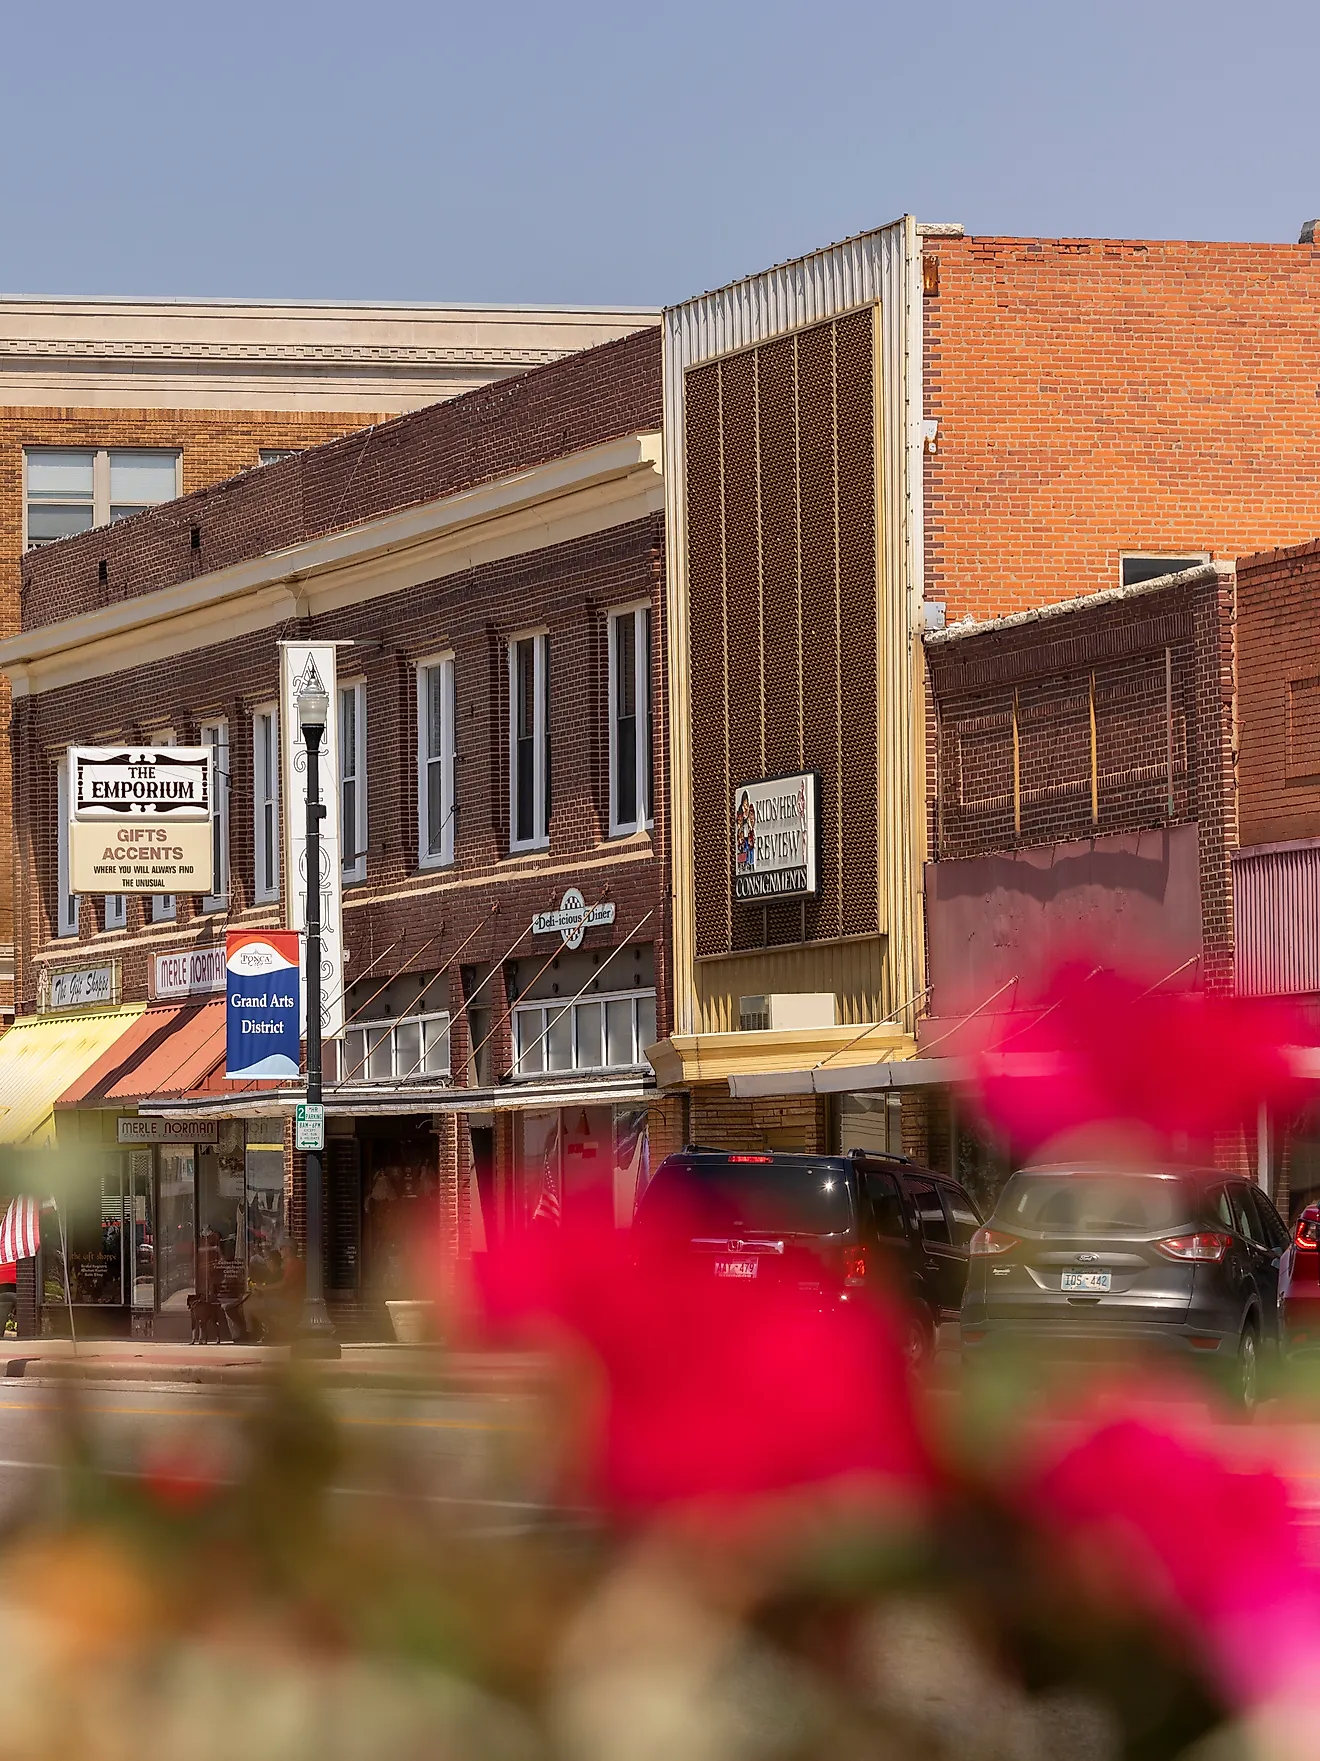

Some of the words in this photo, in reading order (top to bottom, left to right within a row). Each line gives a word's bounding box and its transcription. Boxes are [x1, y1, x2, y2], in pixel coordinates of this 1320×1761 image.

[128, 766, 156, 779] THE
[91, 781, 195, 799] EMPORIUM
[117, 828, 168, 842] GIFTS
[293, 652, 334, 1030] ATQUS
[101, 846, 184, 860] ACCENTS
[756, 830, 800, 861] REVIEW
[93, 865, 116, 874] WHERE
[118, 865, 132, 874] YOU
[133, 865, 150, 874] WILL
[151, 865, 177, 874] ALWAYS
[178, 865, 194, 874] FIND
[122, 878, 134, 888] THE
[135, 878, 165, 888] UNUSUAL
[736, 867, 808, 898] CONSIGNMENTS
[583, 908, 611, 923] Diner
[242, 954, 271, 963] PONCA
[161, 957, 187, 988] MERLE
[189, 951, 227, 983] NORMAN
[54, 978, 67, 1004] The
[69, 973, 83, 1002] Gift
[85, 971, 110, 998] Shoppe
[231, 993, 267, 1008] Grand
[270, 993, 295, 1008] Arts
[241, 1019, 285, 1034] District
[298, 1107, 305, 1119] 2
[122, 1122, 157, 1134] MERLE
[164, 1122, 214, 1134] NORMAN
